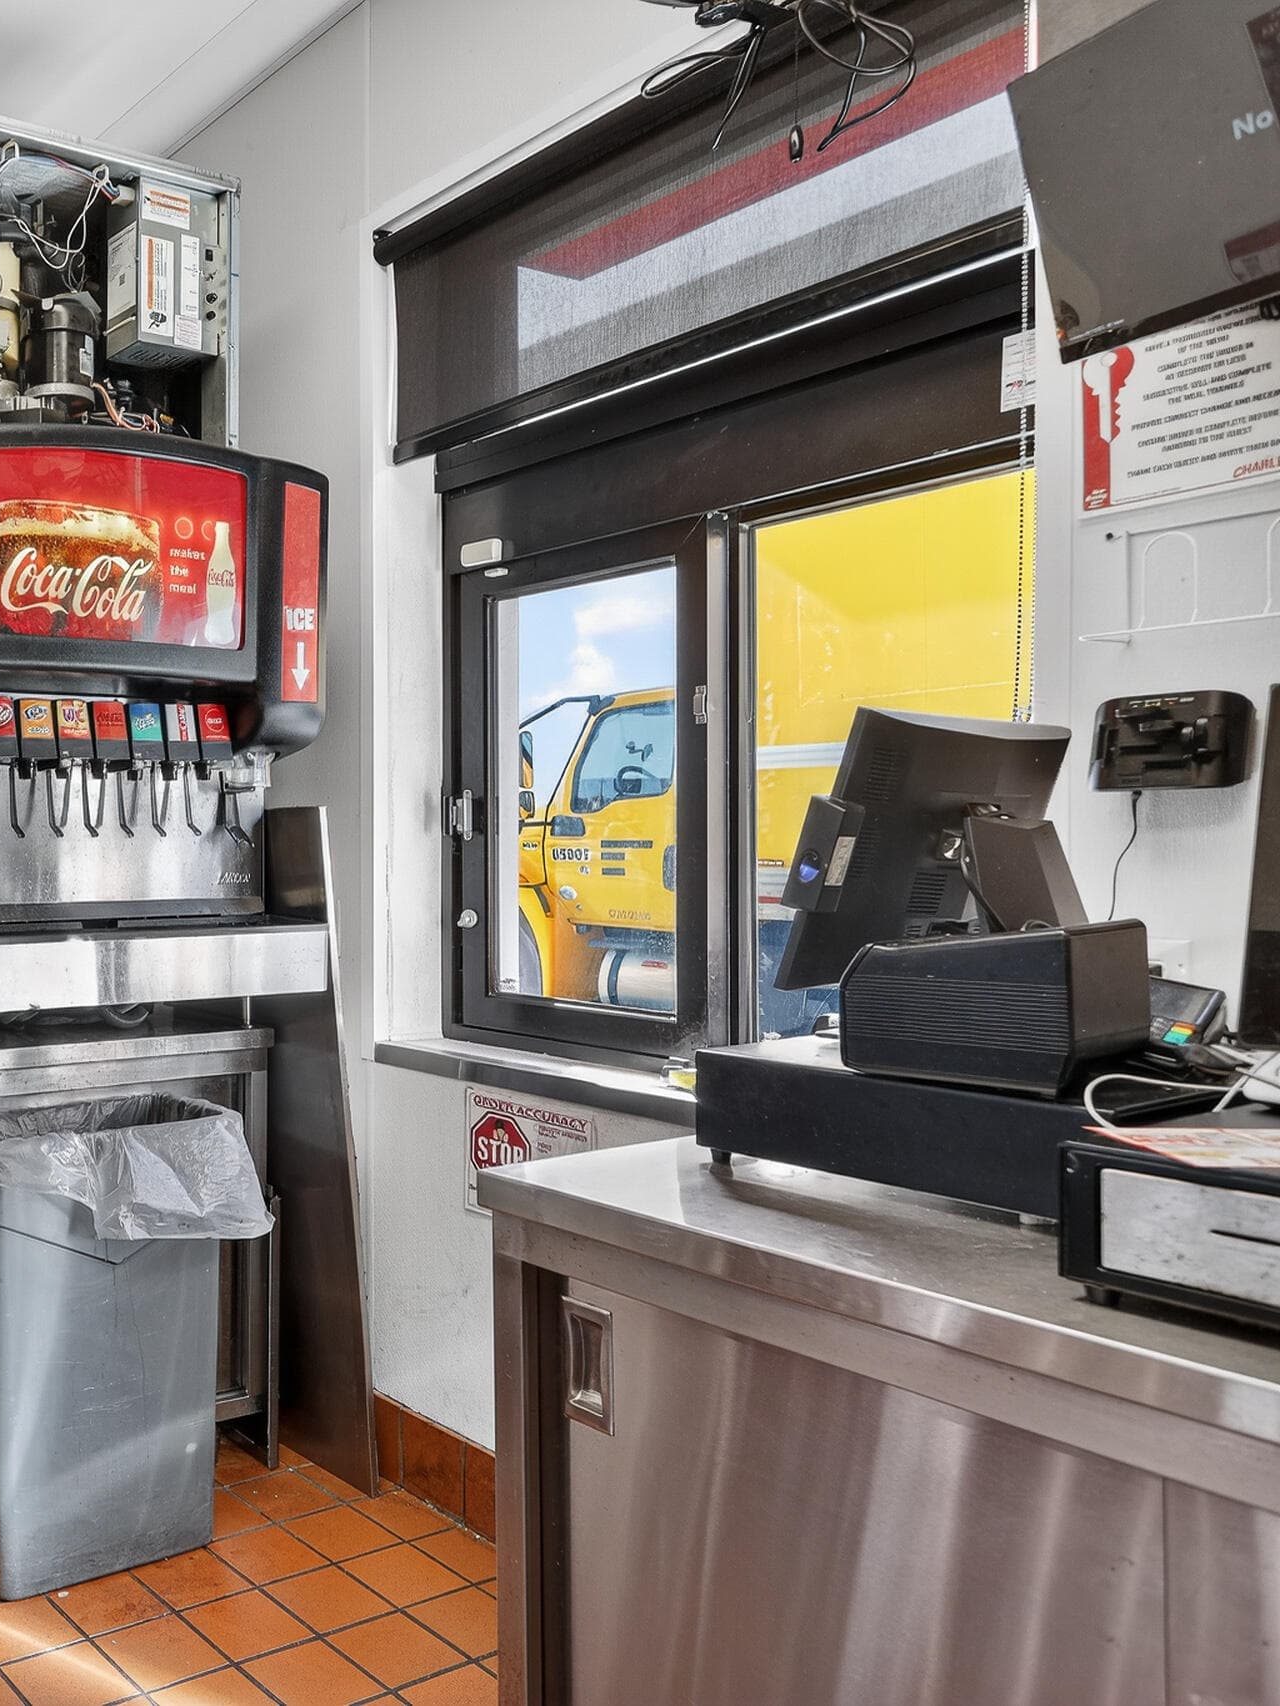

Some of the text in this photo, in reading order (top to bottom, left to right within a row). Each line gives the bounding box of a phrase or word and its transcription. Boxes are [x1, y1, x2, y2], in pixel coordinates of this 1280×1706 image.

[1232, 110, 1273, 140] No
[169, 564, 190, 577] the
[0, 546, 154, 623] Coca-Cola
[169, 583, 197, 595] meal
[285, 607, 315, 631] ICE
